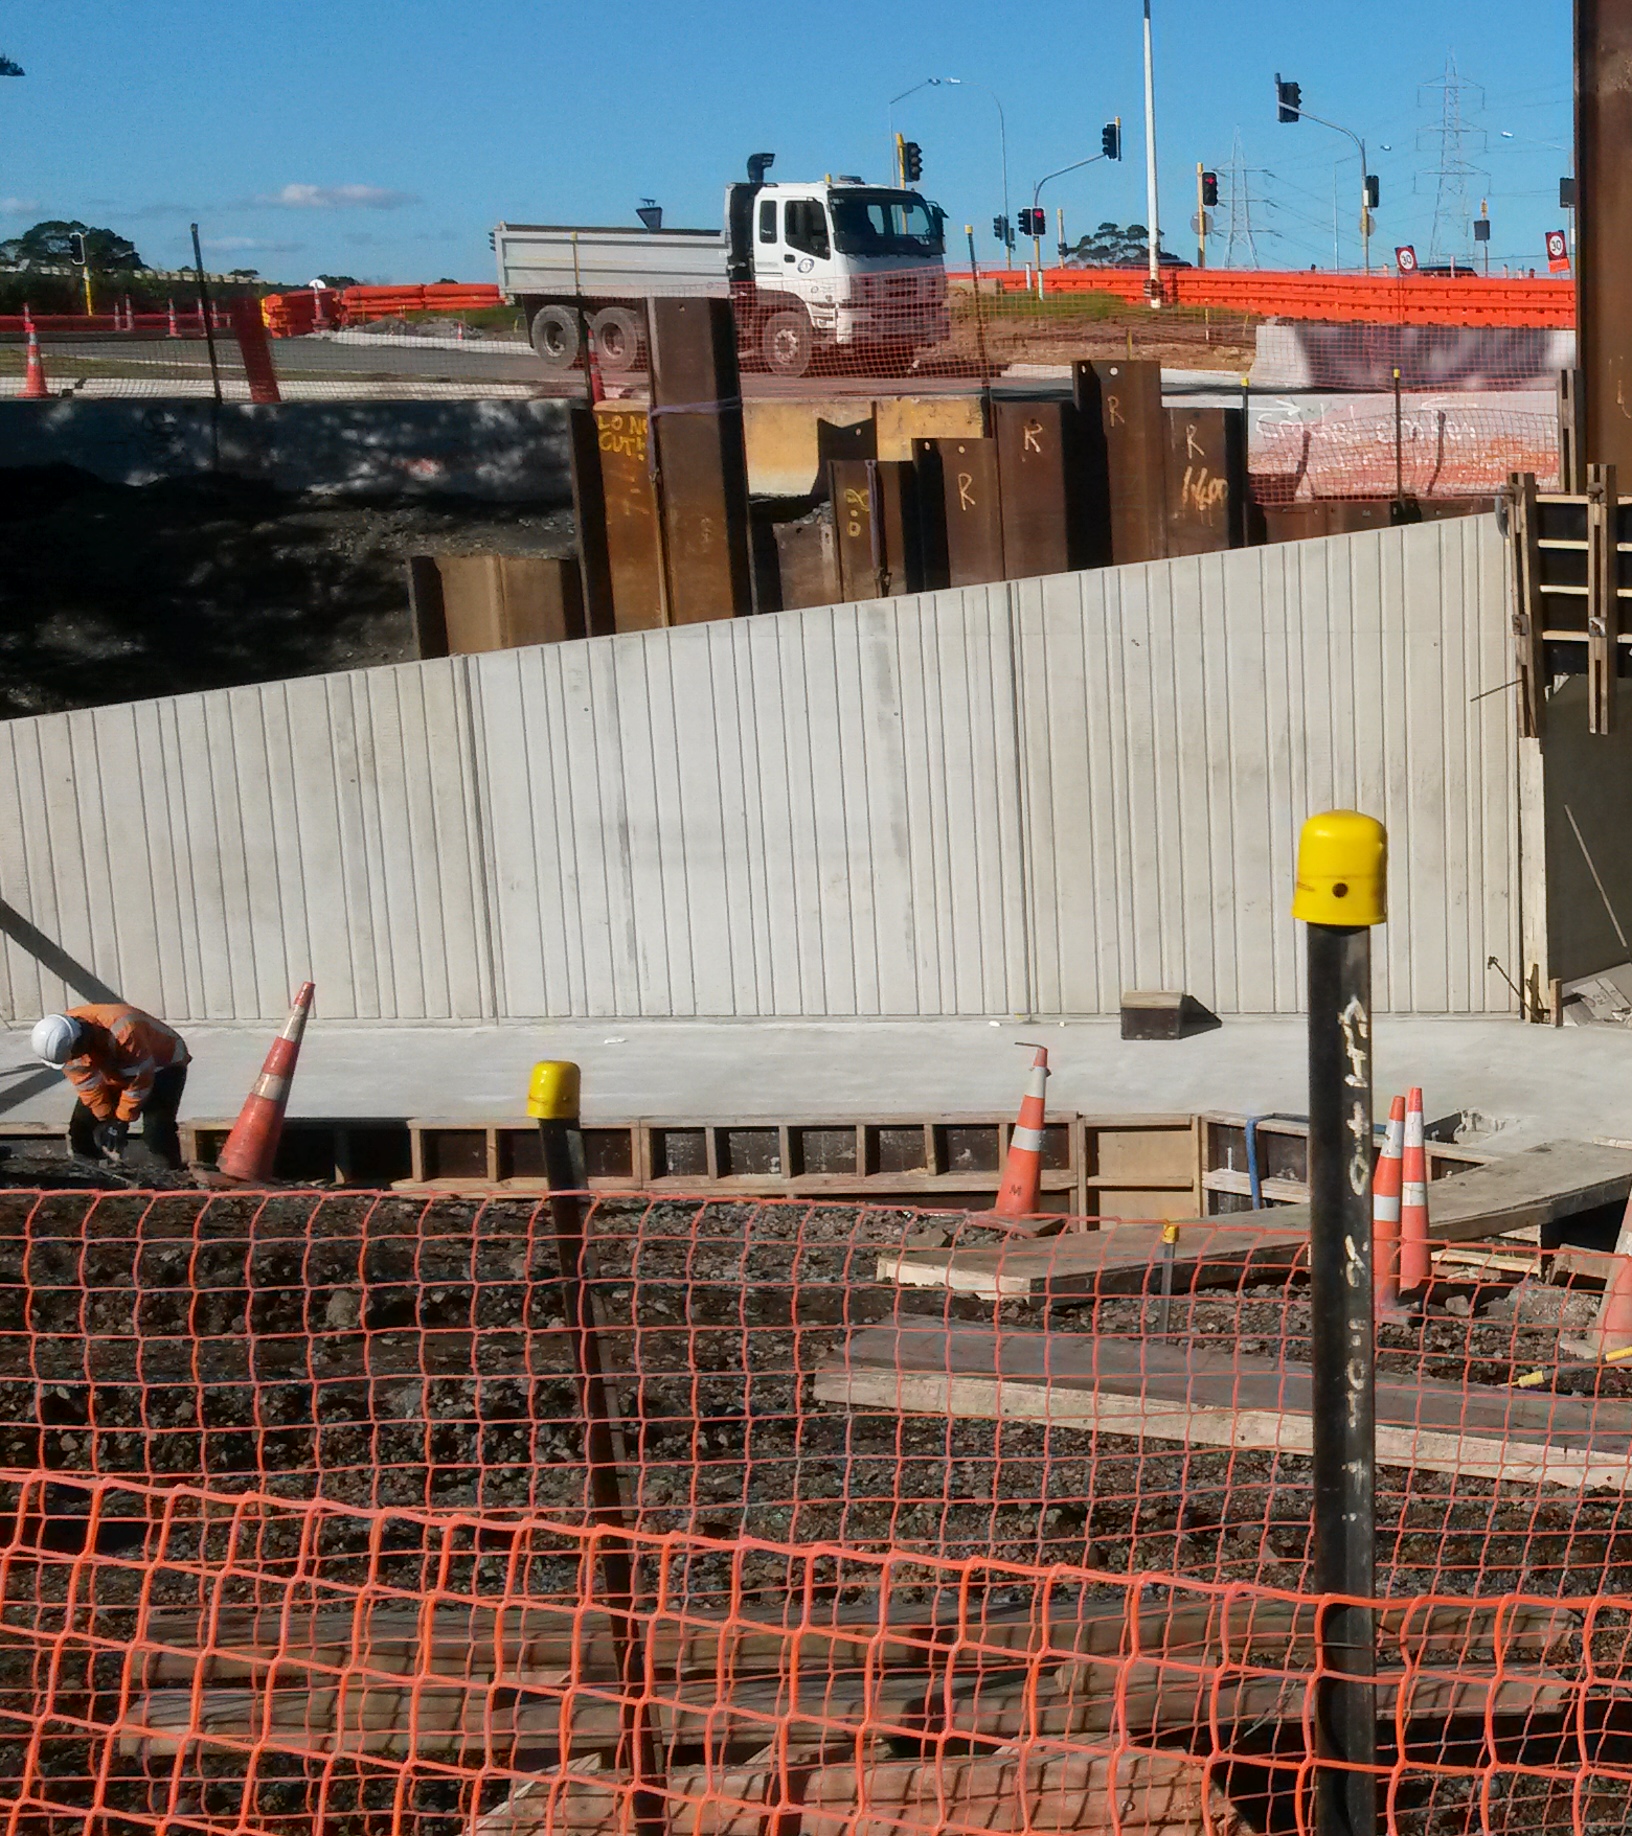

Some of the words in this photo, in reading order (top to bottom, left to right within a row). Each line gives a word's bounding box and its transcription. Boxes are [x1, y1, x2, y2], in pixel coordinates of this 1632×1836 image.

[1400, 254, 1412, 266] 30
[1551, 239, 1562, 251] 30
[1108, 395, 1126, 428] R
[1022, 422, 1043, 453] R
[1185, 423, 1206, 460] R
[957, 472, 977, 511] R
